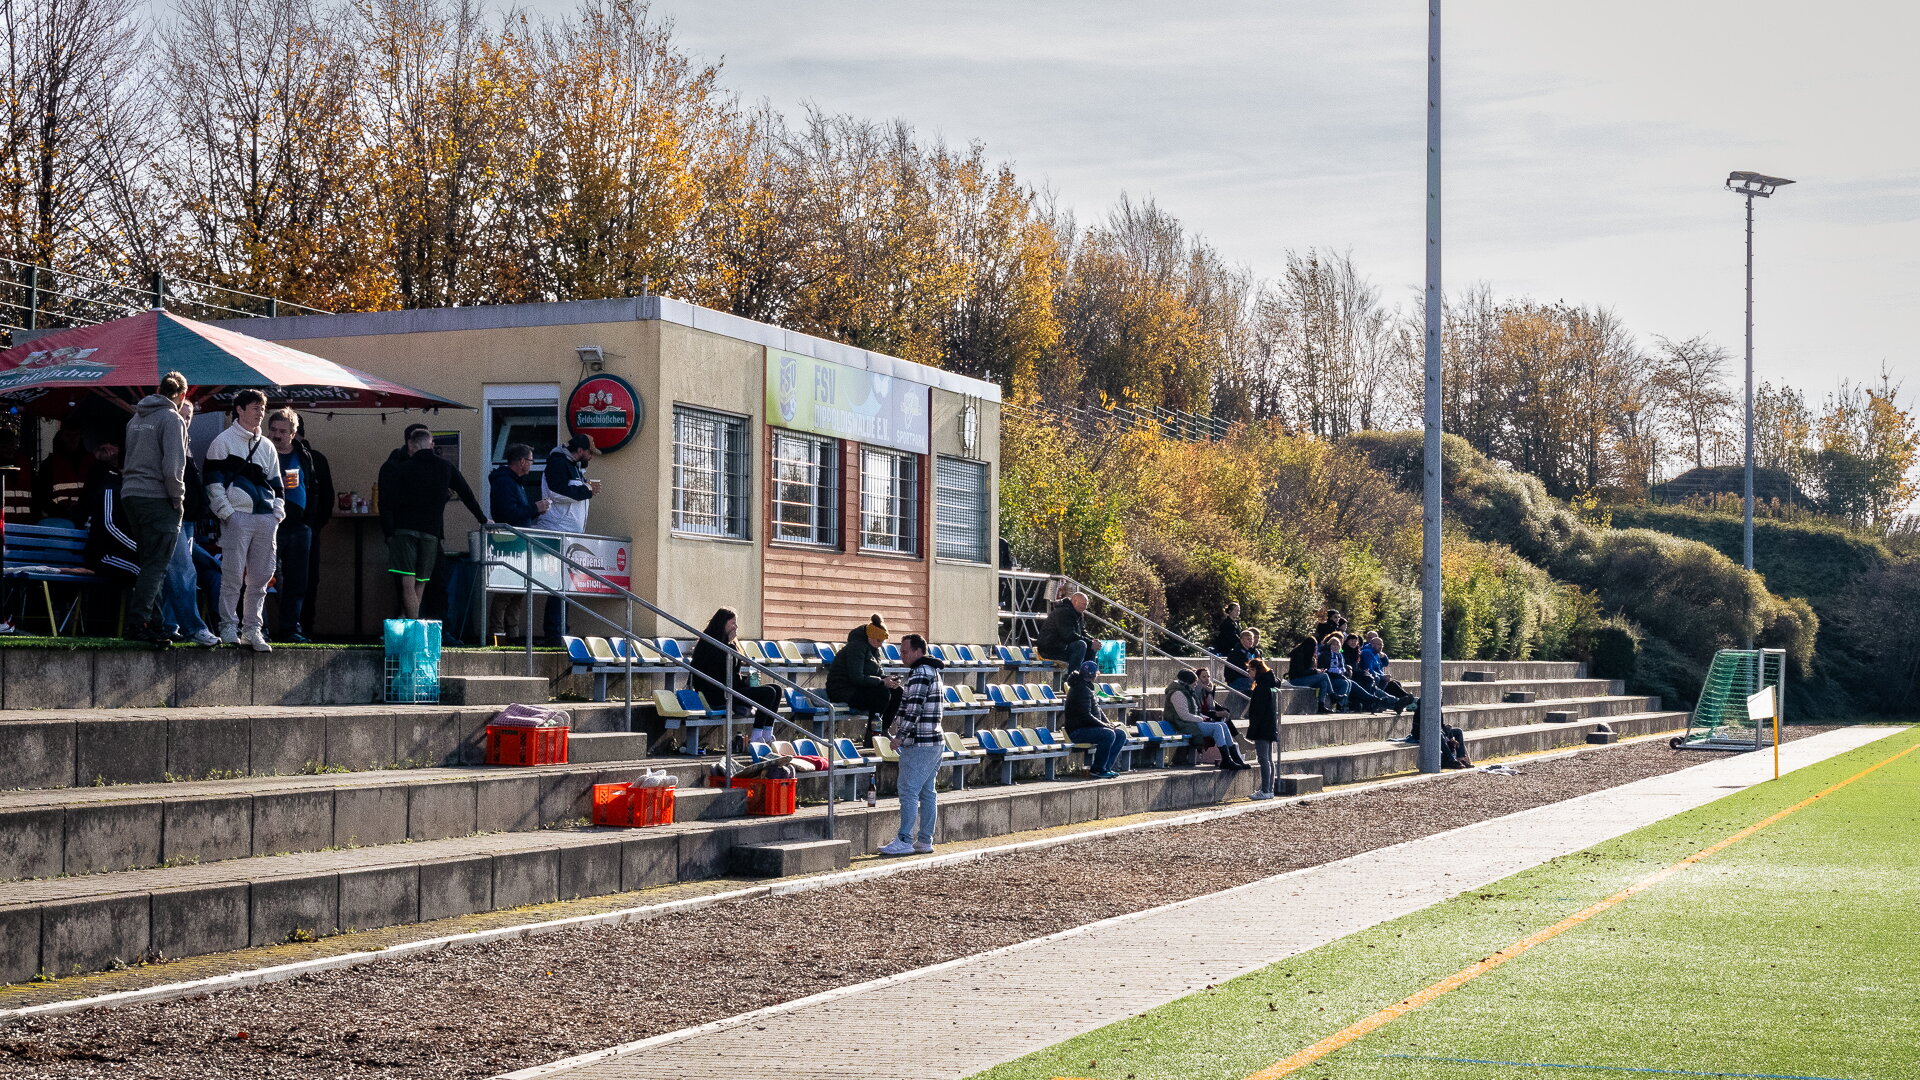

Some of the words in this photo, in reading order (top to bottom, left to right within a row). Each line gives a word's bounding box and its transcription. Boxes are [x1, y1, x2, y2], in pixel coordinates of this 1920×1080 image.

[780, 361, 797, 393] FSV
[814, 364, 836, 405] FSV
[577, 413, 625, 426] Feldschlößchen
[814, 404, 876, 438] DIPPOLDISWALDE
[877, 418, 890, 442] E.V.
[897, 429, 926, 448] SPORTPARK
